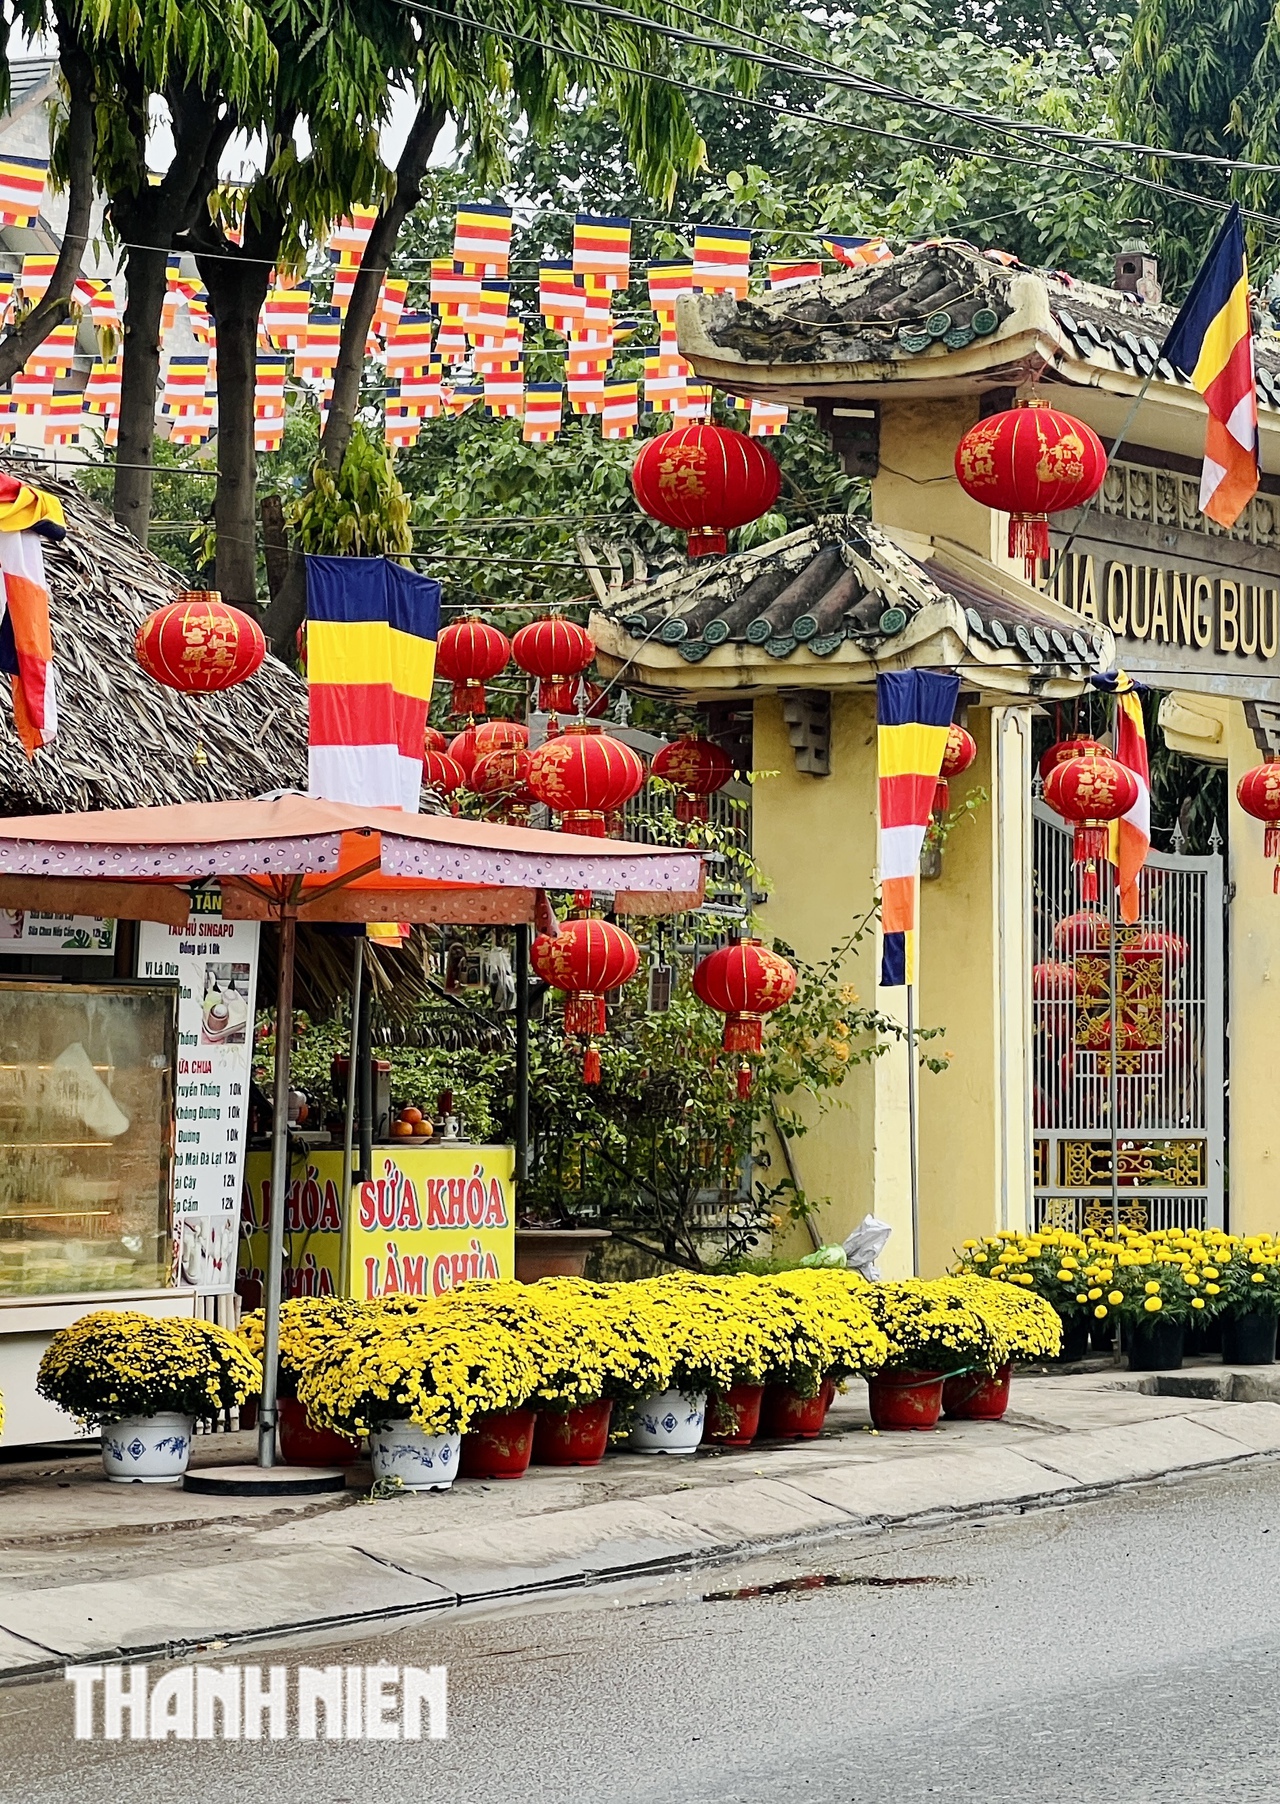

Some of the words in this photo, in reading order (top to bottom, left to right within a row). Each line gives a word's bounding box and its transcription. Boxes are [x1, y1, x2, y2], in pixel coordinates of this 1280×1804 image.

[1035, 547, 1098, 620] HUA
[1107, 561, 1212, 648] QUANG
[195, 892, 222, 913] TẶN
[199, 923, 234, 937] SINGAPO
[192, 1061, 212, 1074] CHUA
[230, 1083, 241, 1095] 10k
[228, 1106, 240, 1118] 10k
[227, 1129, 238, 1141] 10k
[186, 1152, 198, 1165] Mai
[225, 1152, 236, 1164] 12k
[224, 1174, 235, 1187] 12k
[360, 1159, 419, 1229] SỬA
[427, 1164, 506, 1228] KHÓA
[222, 1197, 233, 1209] 12k
[364, 1242, 426, 1301] LÀM
[433, 1240, 499, 1298] CHÌA
